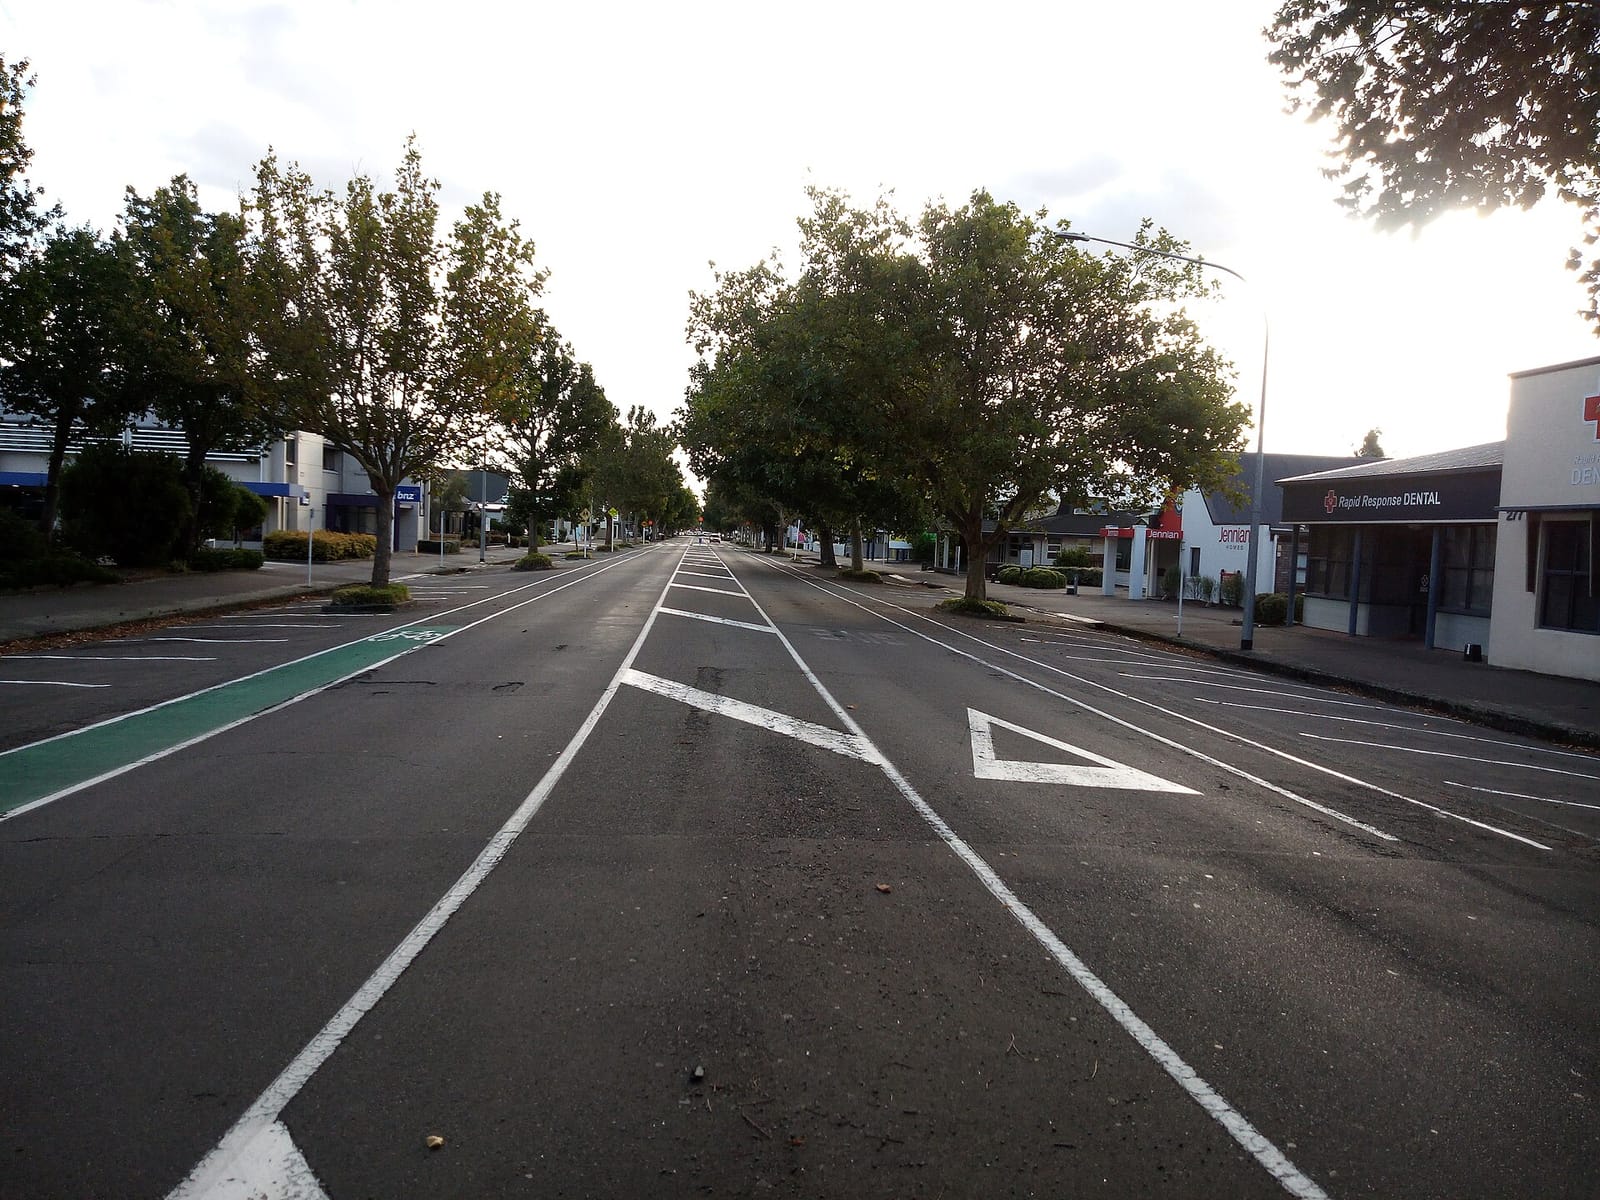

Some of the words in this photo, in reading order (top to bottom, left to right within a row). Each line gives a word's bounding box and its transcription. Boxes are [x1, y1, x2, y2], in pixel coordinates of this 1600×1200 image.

[397, 491, 414, 500] bnz
[1339, 496, 1361, 510] Rapid
[1361, 495, 1402, 509] Response
[1403, 491, 1441, 506] DENTAL
[1148, 530, 1179, 539] Jennian
[1219, 527, 1251, 543] Jennian
